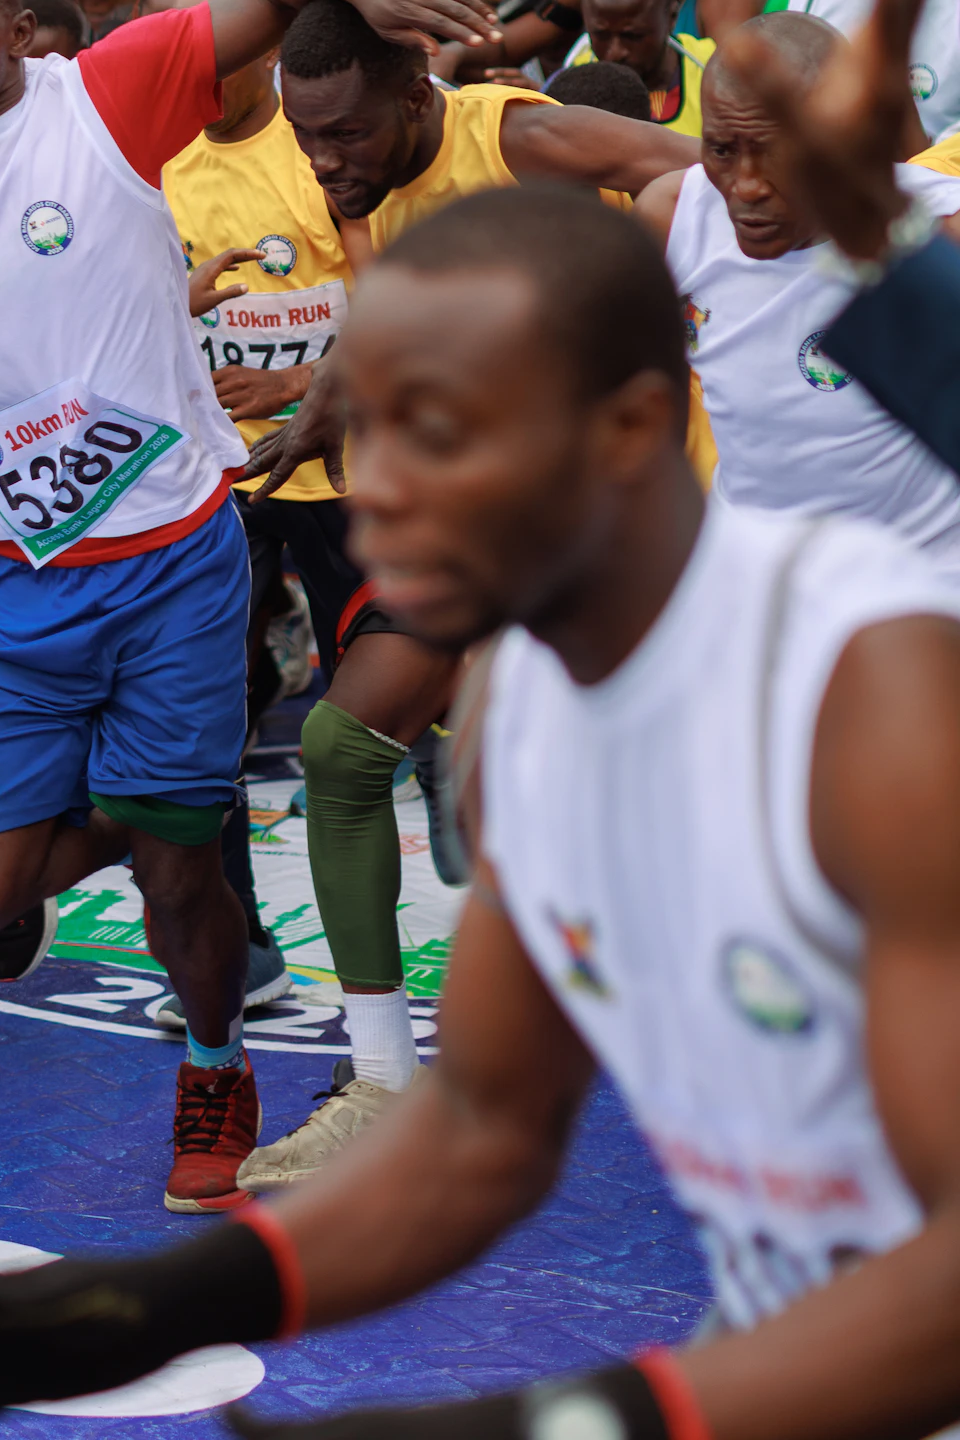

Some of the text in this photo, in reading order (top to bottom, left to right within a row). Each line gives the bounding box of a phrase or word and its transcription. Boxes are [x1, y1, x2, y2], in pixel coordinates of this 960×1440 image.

[226, 302, 332, 328] 10km RUN
[4, 413, 64, 452] 10km
[60, 398, 90, 426] RUN
[35, 432, 171, 549] Access Bank Lagos City Marathon 2026
